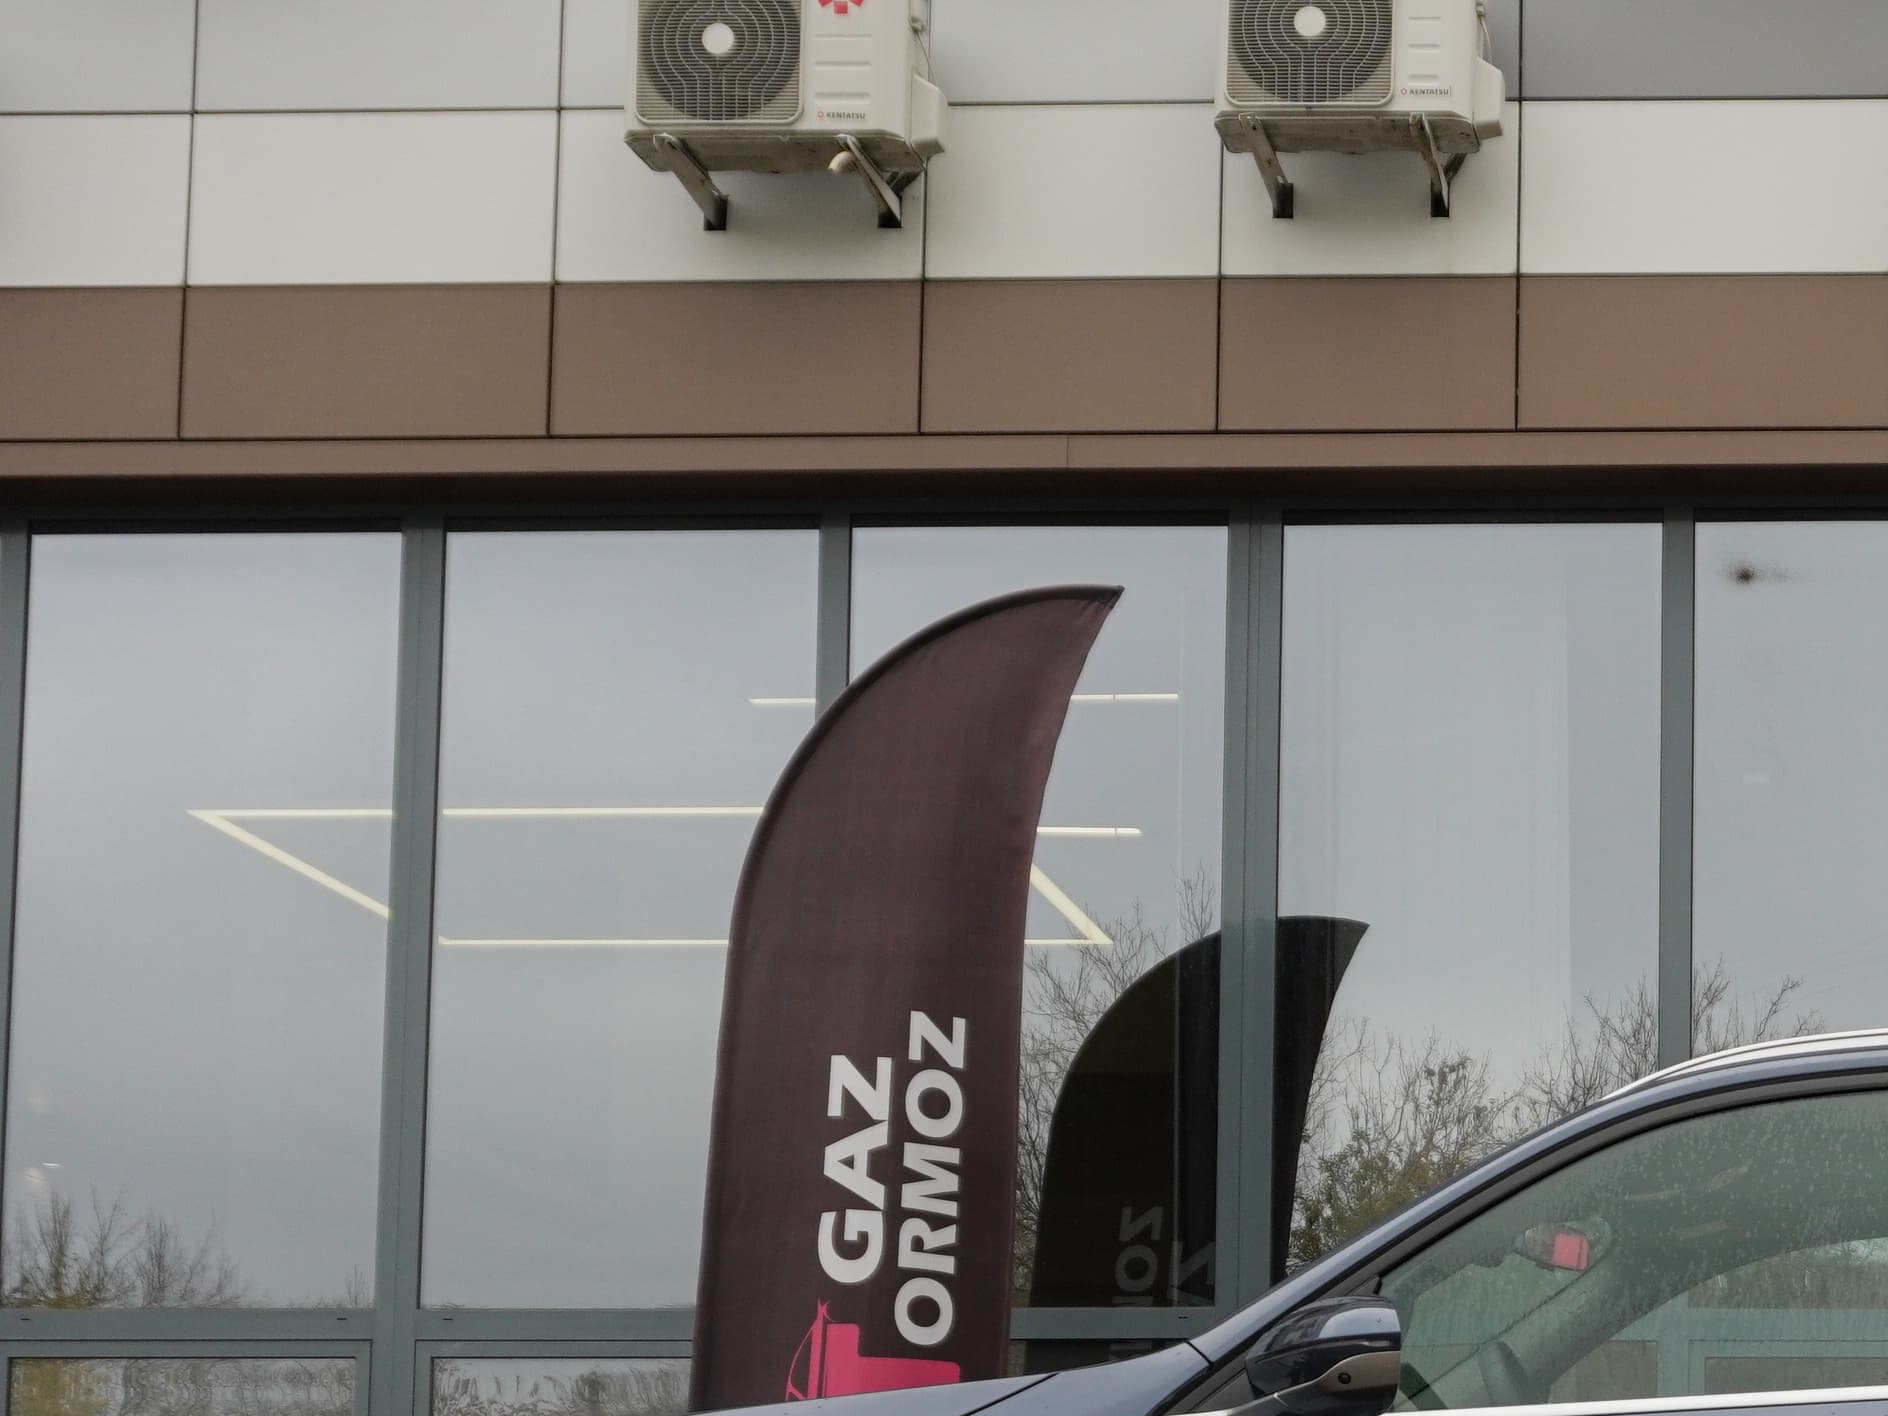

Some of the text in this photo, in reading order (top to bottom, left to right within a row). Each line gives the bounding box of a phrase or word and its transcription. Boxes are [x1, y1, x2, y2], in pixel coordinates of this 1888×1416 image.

[1409, 87, 1449, 96] KENTATSU
[826, 111, 866, 120] KENTATSU
[817, 1055, 892, 1284] GAZ
